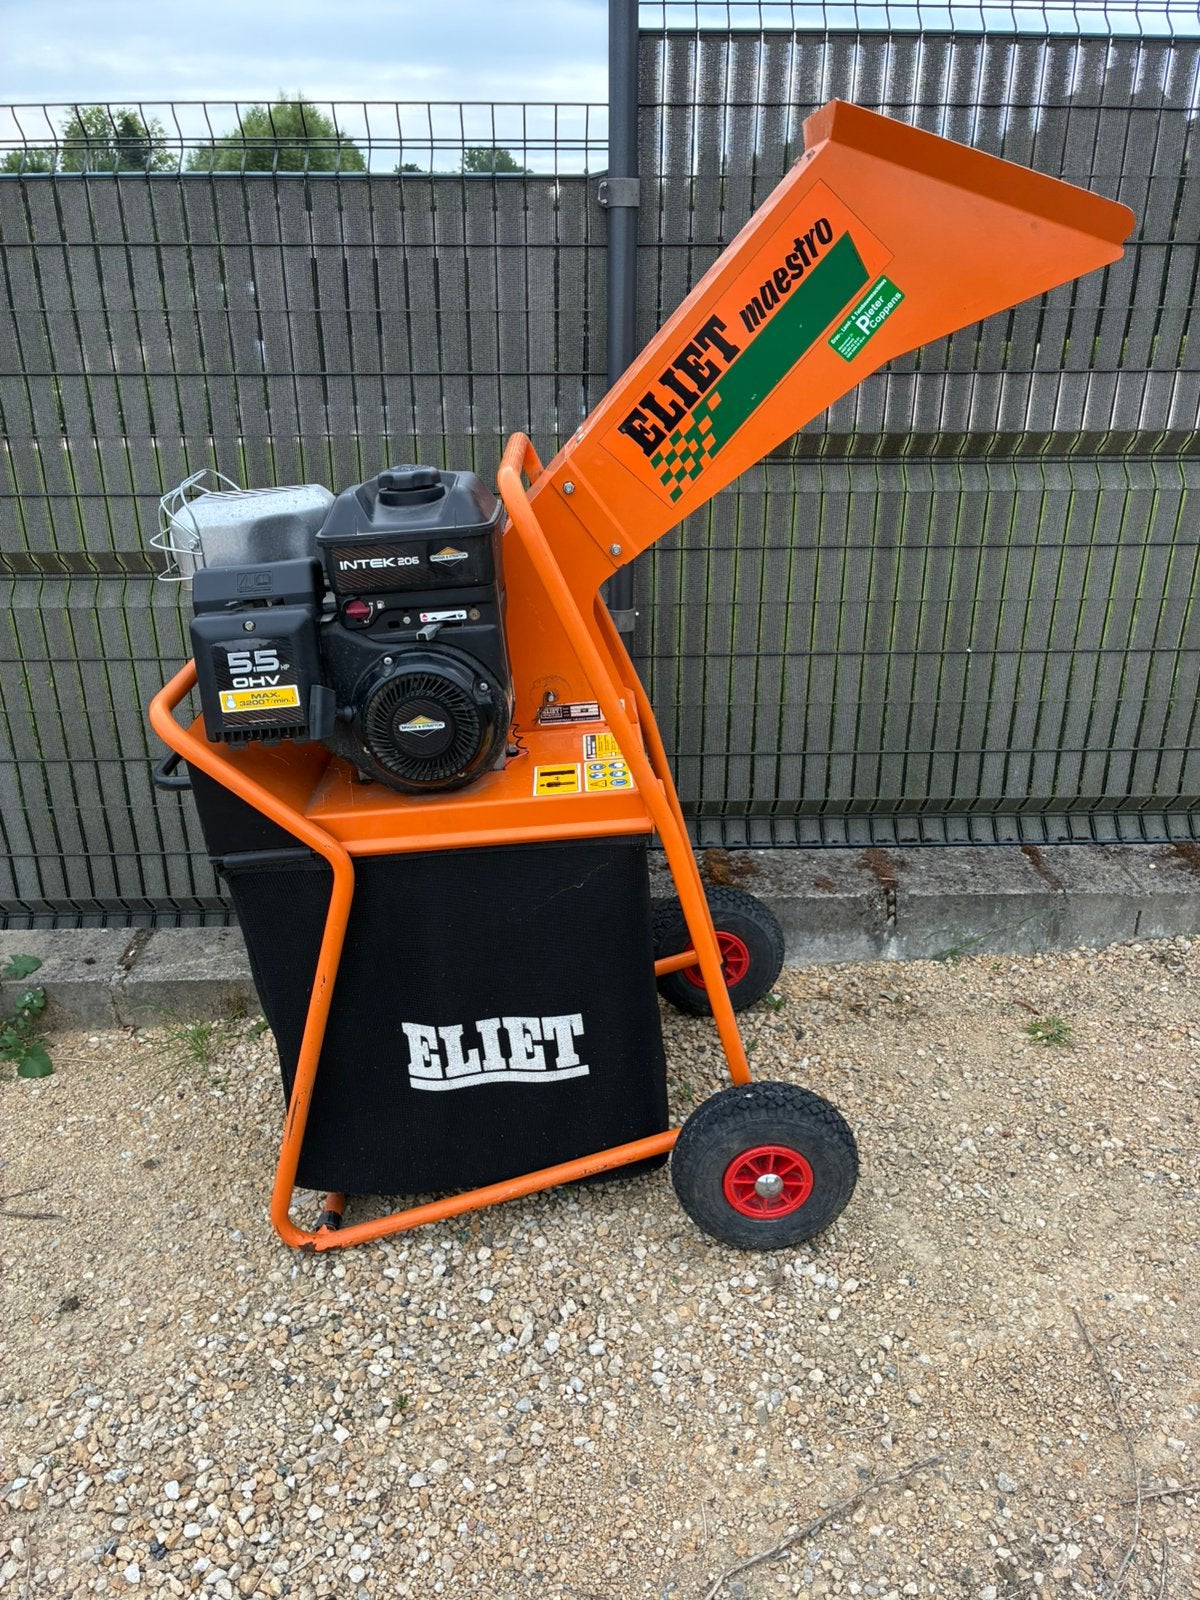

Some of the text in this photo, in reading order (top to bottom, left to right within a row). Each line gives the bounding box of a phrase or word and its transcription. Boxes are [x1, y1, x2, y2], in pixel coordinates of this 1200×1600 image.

[855, 295, 885, 336] Pieter
[869, 292, 902, 329] Coppens
[617, 217, 834, 457] ELIET maestro
[339, 556, 420, 571] INTEK 206
[227, 649, 290, 674] 5.5 HP
[232, 675, 280, 688] OHV
[250, 691, 280, 700] MAX.
[401, 1013, 585, 1079] ELIET
